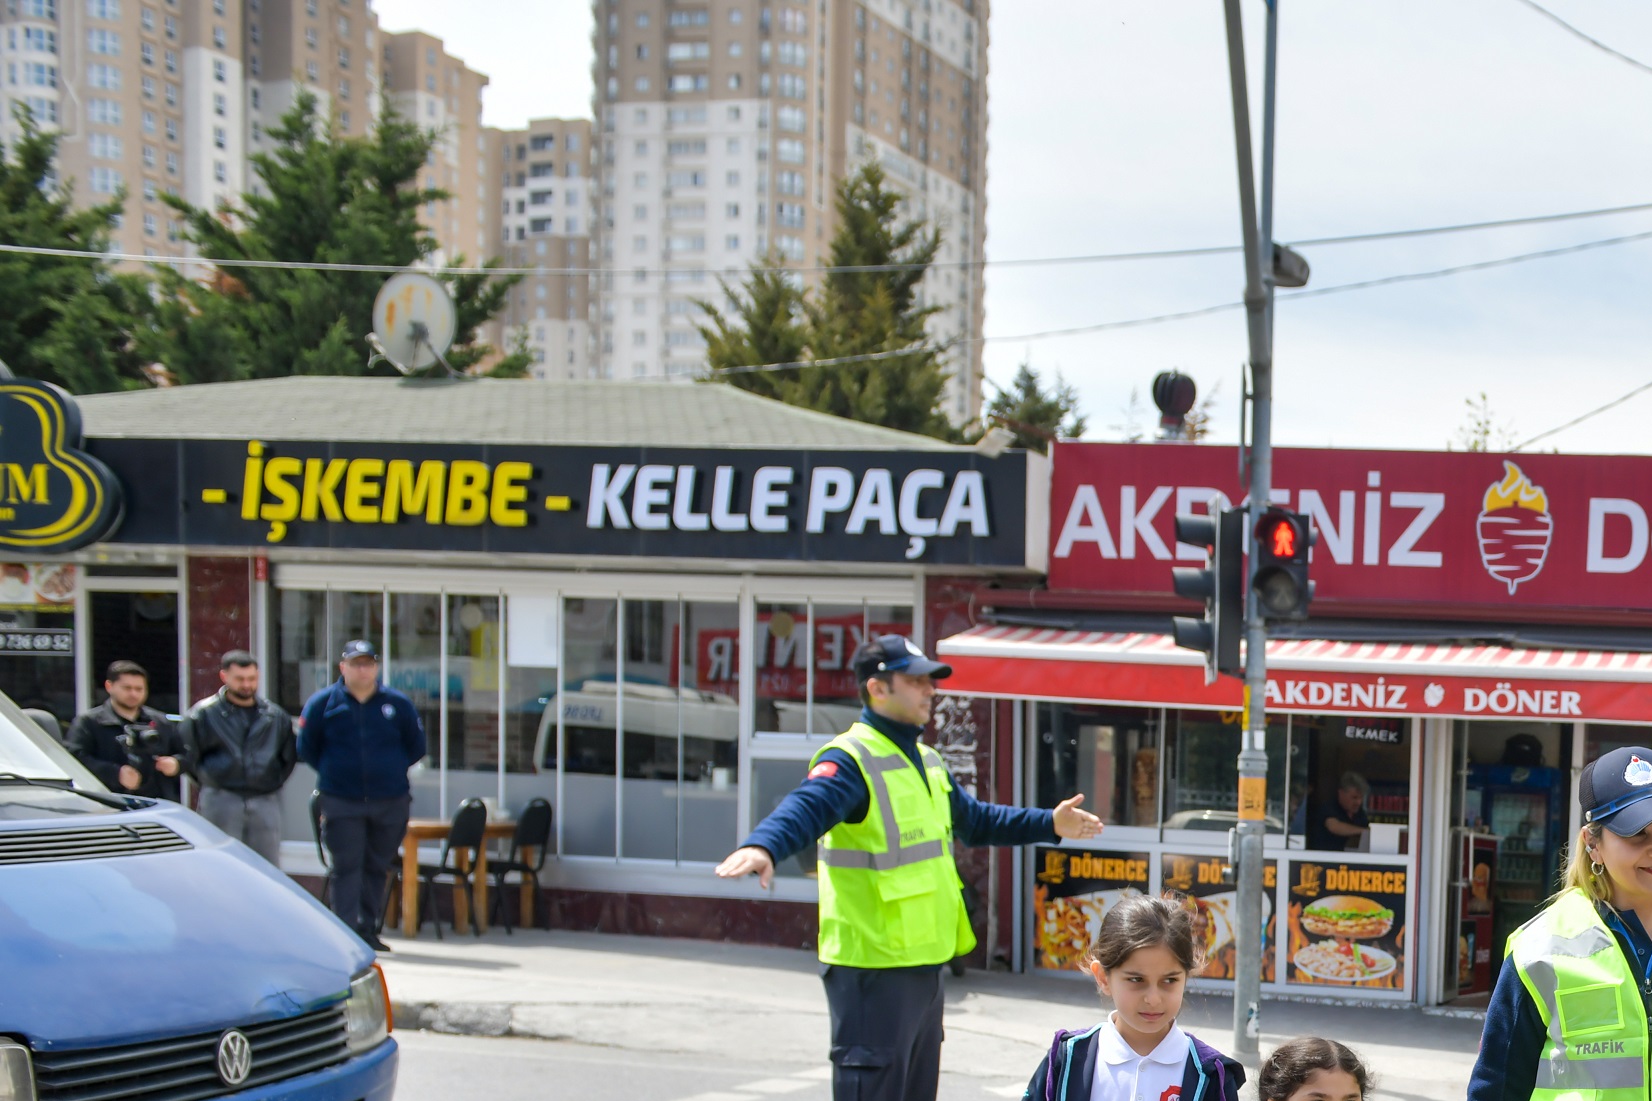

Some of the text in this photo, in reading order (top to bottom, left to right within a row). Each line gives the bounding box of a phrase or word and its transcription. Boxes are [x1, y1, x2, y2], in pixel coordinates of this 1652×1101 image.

[241, 439, 533, 543] İŞKEMBE
[586, 462, 794, 533] KELLE
[805, 466, 990, 560] PAÇA
[1264, 676, 1583, 716] AKDENİZ DÖNER
[1345, 725, 1398, 743] EKMEK
[1069, 851, 1148, 882] DÖNERCE
[1325, 864, 1405, 894] DÖNERCE
[1575, 1039, 1625, 1056] TRAFİK
